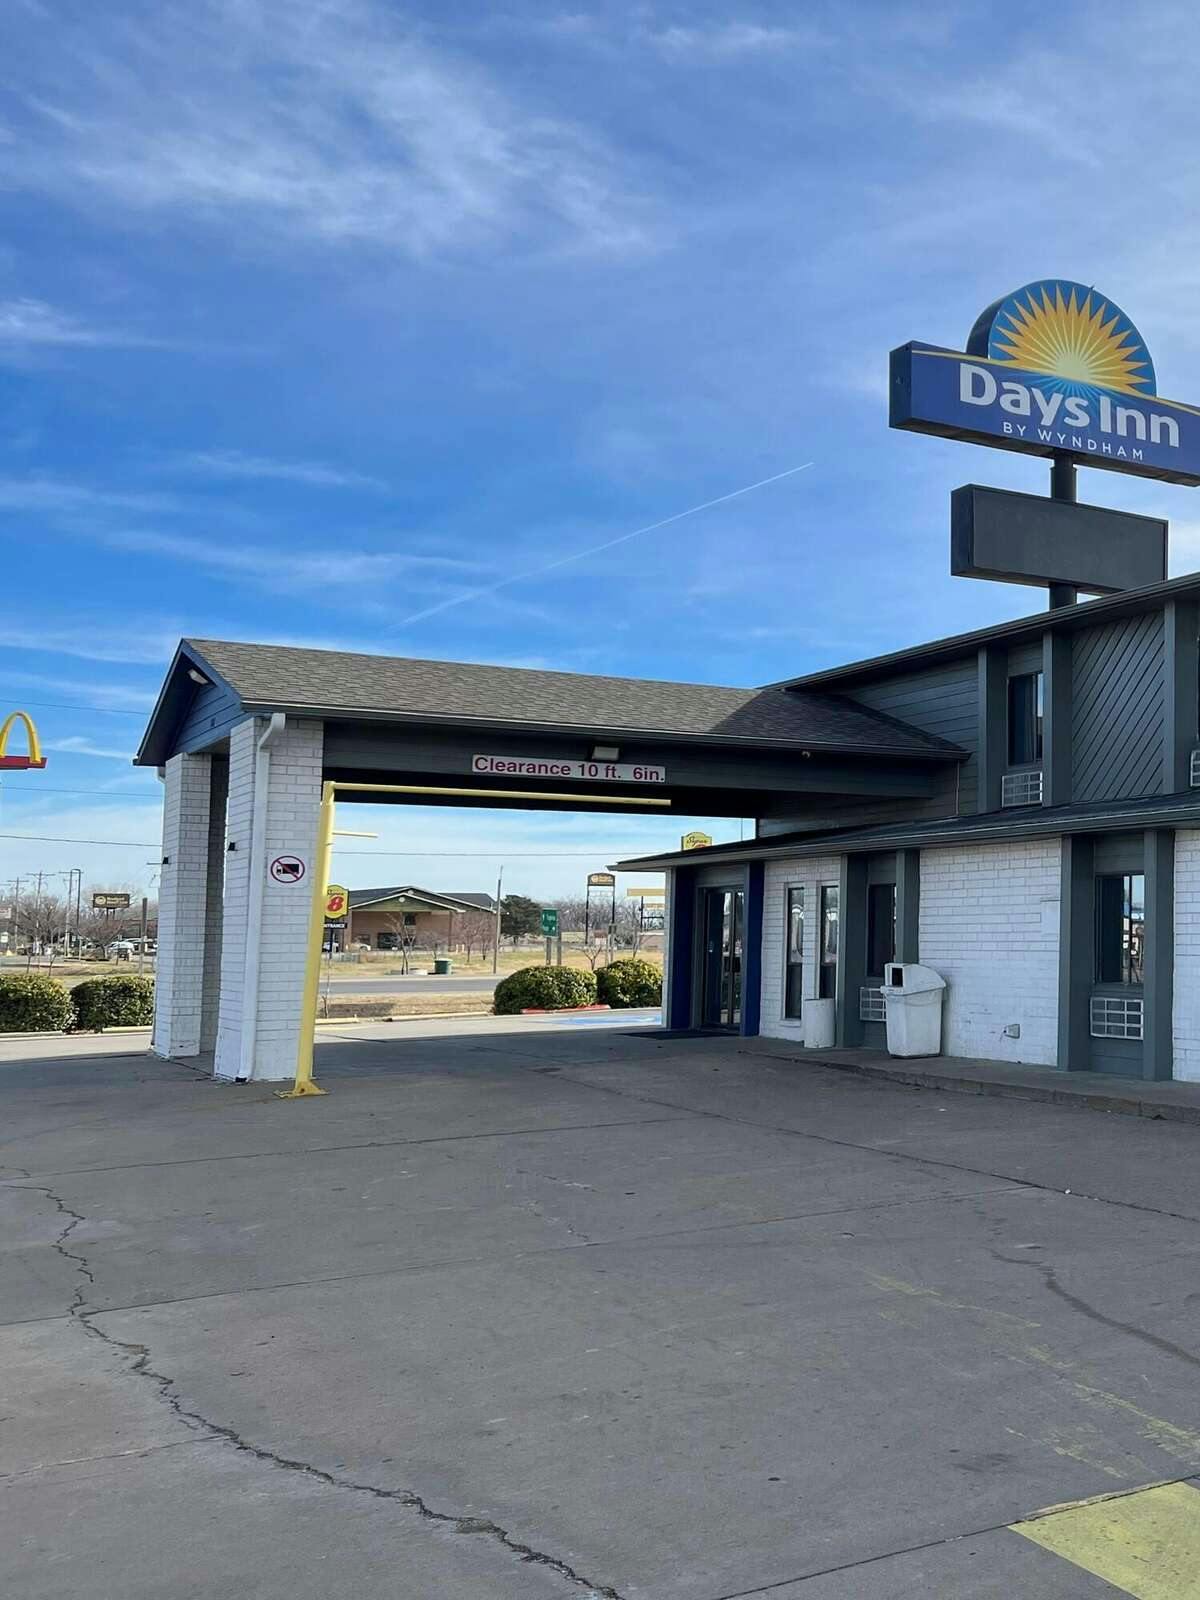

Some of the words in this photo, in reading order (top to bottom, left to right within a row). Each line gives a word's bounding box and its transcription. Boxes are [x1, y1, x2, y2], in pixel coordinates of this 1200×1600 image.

[960, 362, 1091, 428] Days
[1100, 395, 1180, 448] Inn
[1003, 421, 1028, 437] BY
[1037, 428, 1144, 461] WYNDHAM
[474, 756, 571, 776] Clearance
[578, 763, 598, 777] 10
[604, 764, 621, 779] ft.
[633, 766, 665, 782] 6in.
[327, 895, 345, 912] 8
